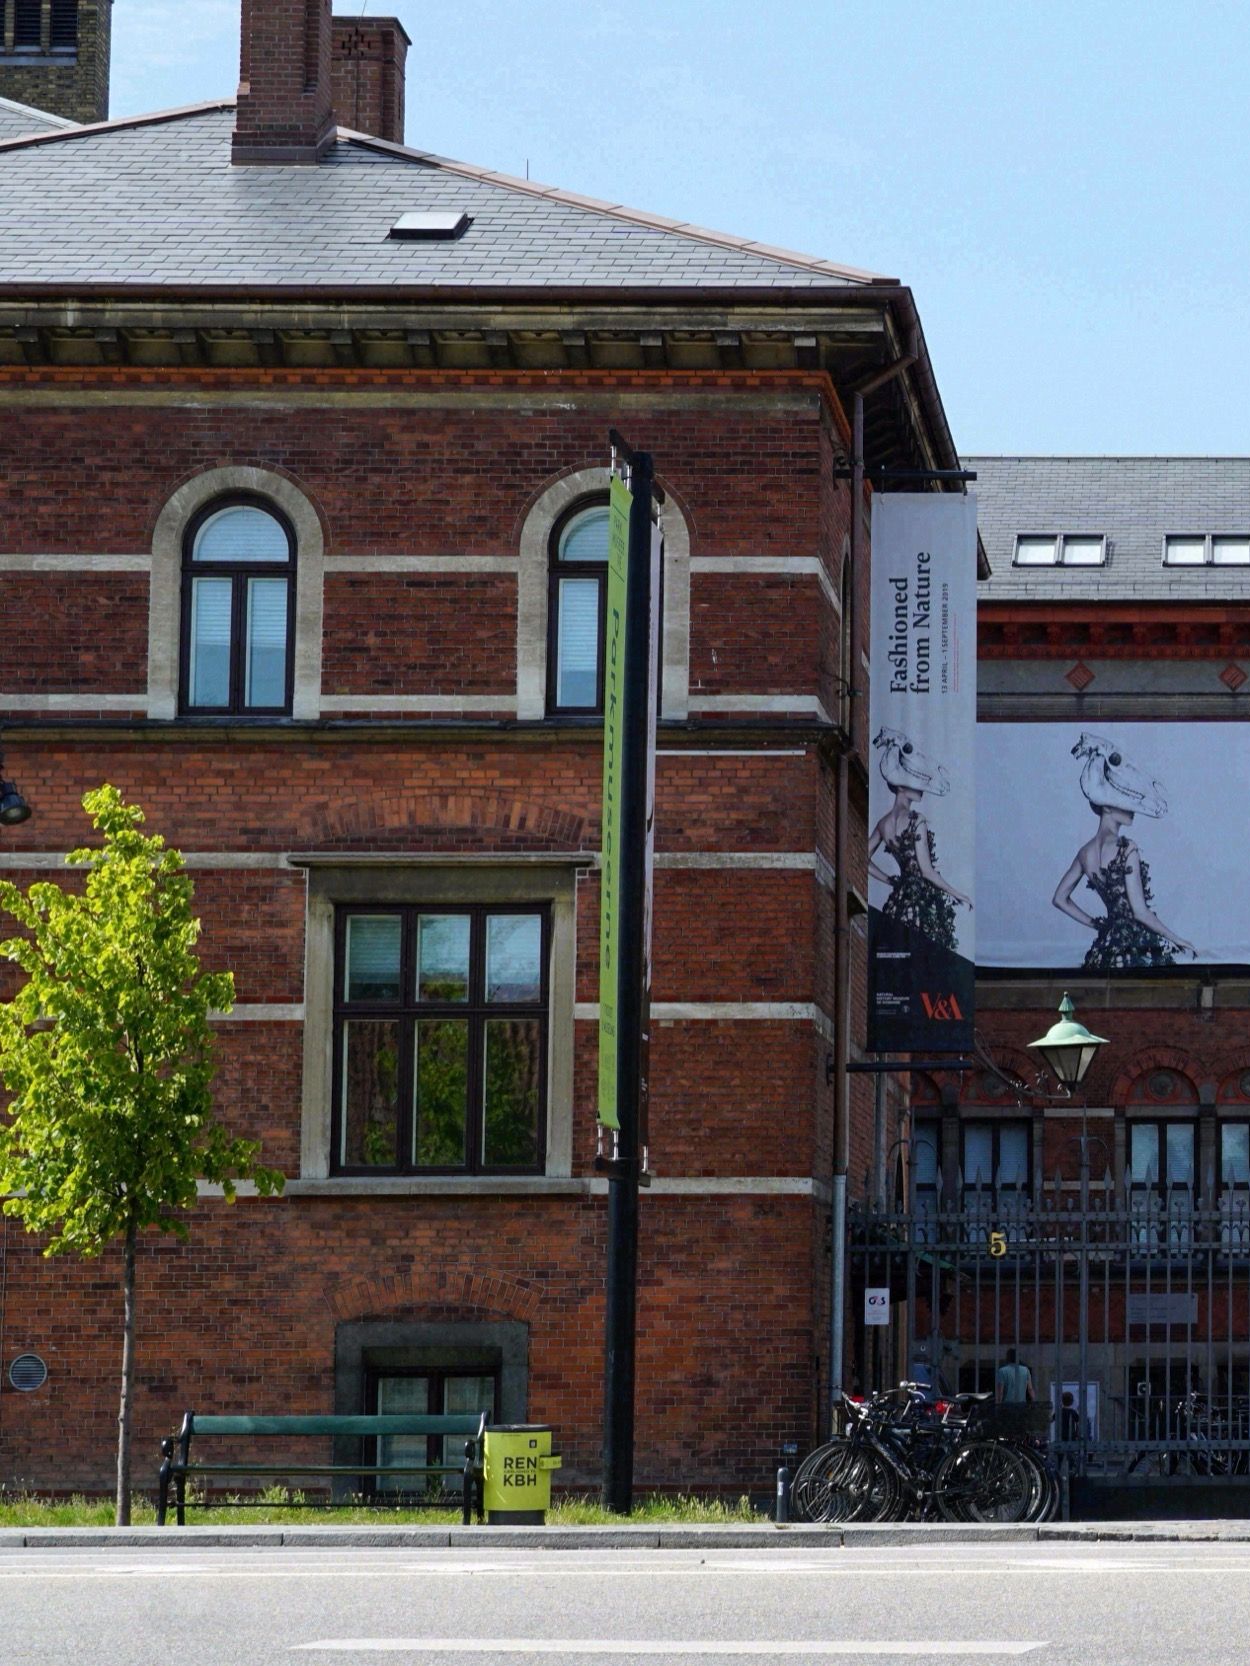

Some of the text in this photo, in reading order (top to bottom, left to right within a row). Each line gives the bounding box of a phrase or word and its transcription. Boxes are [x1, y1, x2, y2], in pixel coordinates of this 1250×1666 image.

[888, 577, 909, 693] Fashioned
[910, 552, 931, 695] from Nature
[942, 684, 948, 694] 13
[920, 992, 965, 1021] V&A
[990, 1231, 1007, 1256] 5
[504, 1456, 537, 1469] REN
[503, 1474, 537, 1487] KBH
